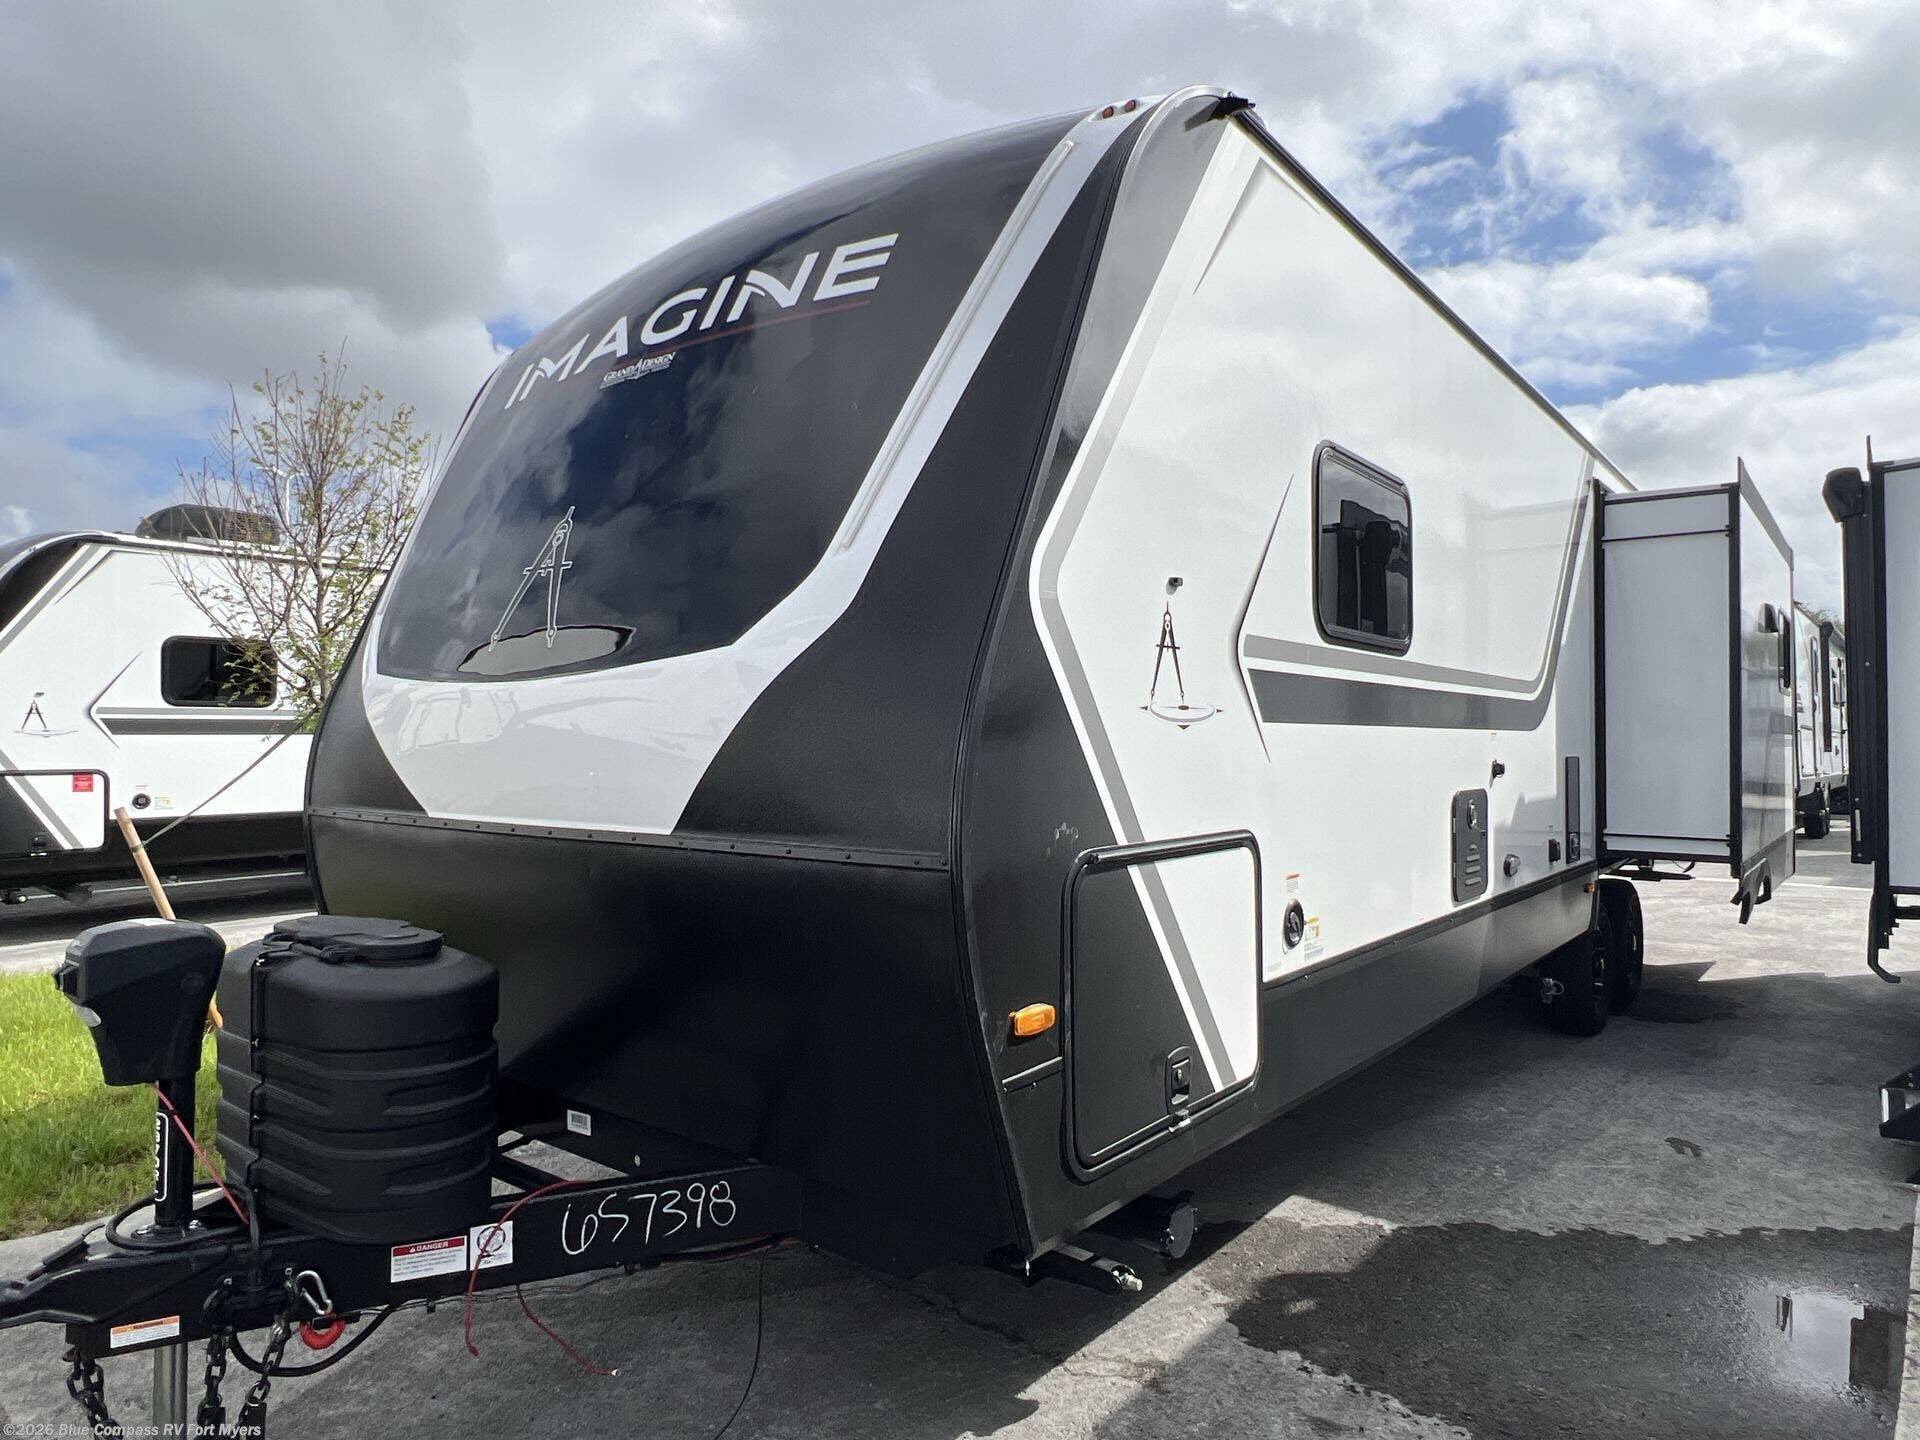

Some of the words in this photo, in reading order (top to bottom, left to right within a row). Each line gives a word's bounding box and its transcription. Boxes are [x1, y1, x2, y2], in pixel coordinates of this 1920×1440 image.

[504, 232, 899, 409] IMAGINE
[416, 1241, 449, 1252] DANGER
[561, 1180, 736, 1256] 657398
